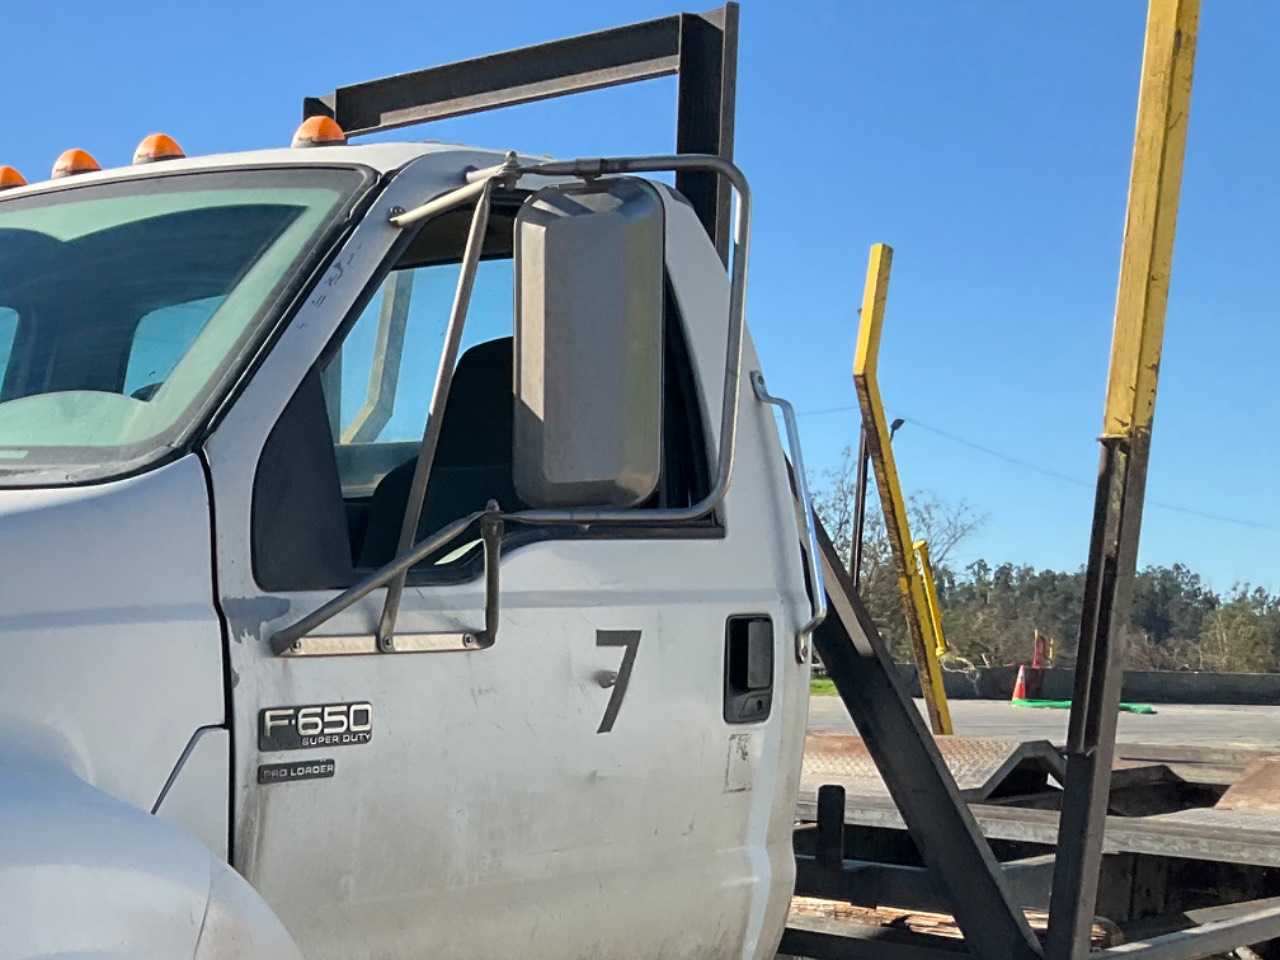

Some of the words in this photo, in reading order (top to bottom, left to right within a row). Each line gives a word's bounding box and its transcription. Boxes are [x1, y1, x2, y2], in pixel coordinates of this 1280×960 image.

[596, 629, 642, 734] 7
[302, 735, 339, 745] SUPER
[342, 733, 370, 743] DUTY
[290, 764, 334, 777] LOADER
